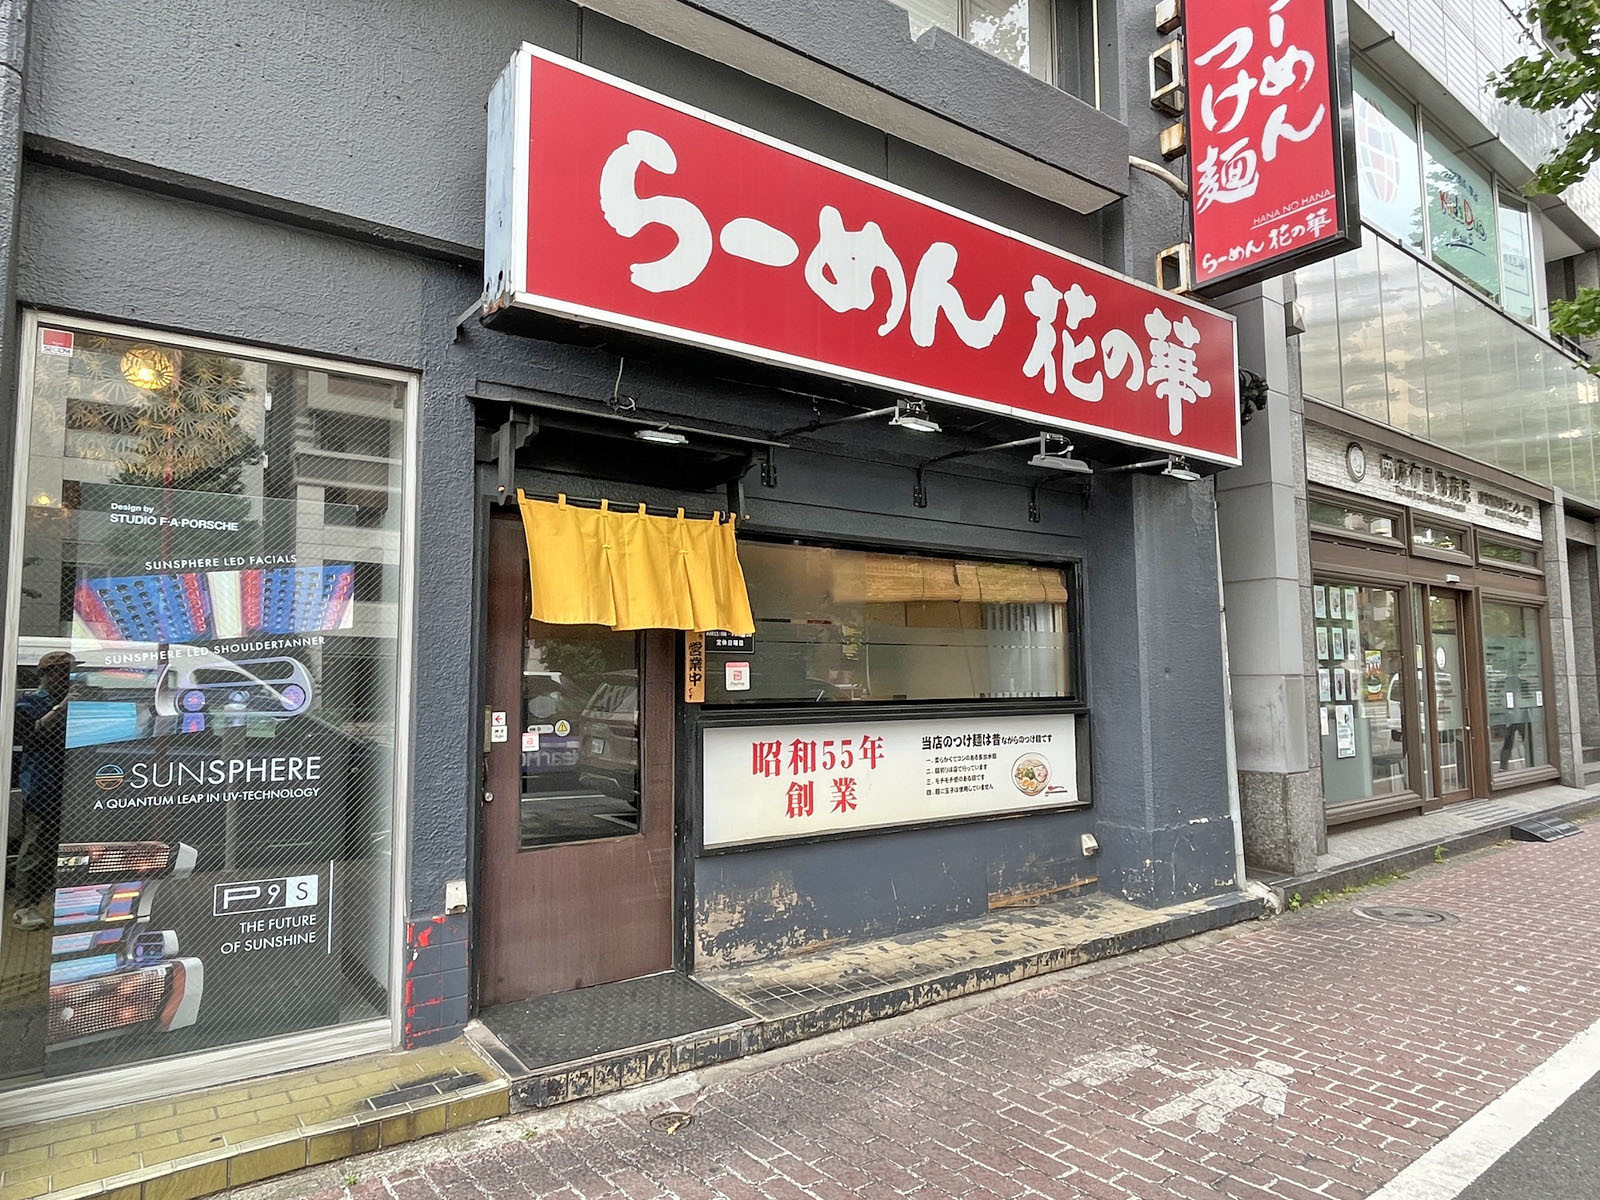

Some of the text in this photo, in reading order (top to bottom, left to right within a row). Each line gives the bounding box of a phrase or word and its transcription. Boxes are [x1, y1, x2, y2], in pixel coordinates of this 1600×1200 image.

[1194, 26, 1260, 215] つけ麺
[1253, 189, 1331, 225] HANA NO HANA
[1202, 207, 1332, 274] らーめん 花の華
[599, 129, 1212, 436] らーめん 花の華
[110, 513, 157, 526] STUDIO
[111, 502, 154, 514] Design by
[144, 554, 297, 571] SUNSPHERE LED FACIALS
[104, 636, 326, 666] SUNSPHERE LED SHOULDERTANNER
[688, 641, 703, 687] 営業中
[129, 756, 322, 790] SUNSPHERE
[752, 735, 885, 778] 昭和55年
[93, 787, 321, 810] A QUANTUM LEAP IN UV-TECHNOLOGY
[785, 777, 858, 819] 創業
[239, 914, 317, 934] THE FUTURE
[220, 931, 317, 955] OF SUNSHINE
